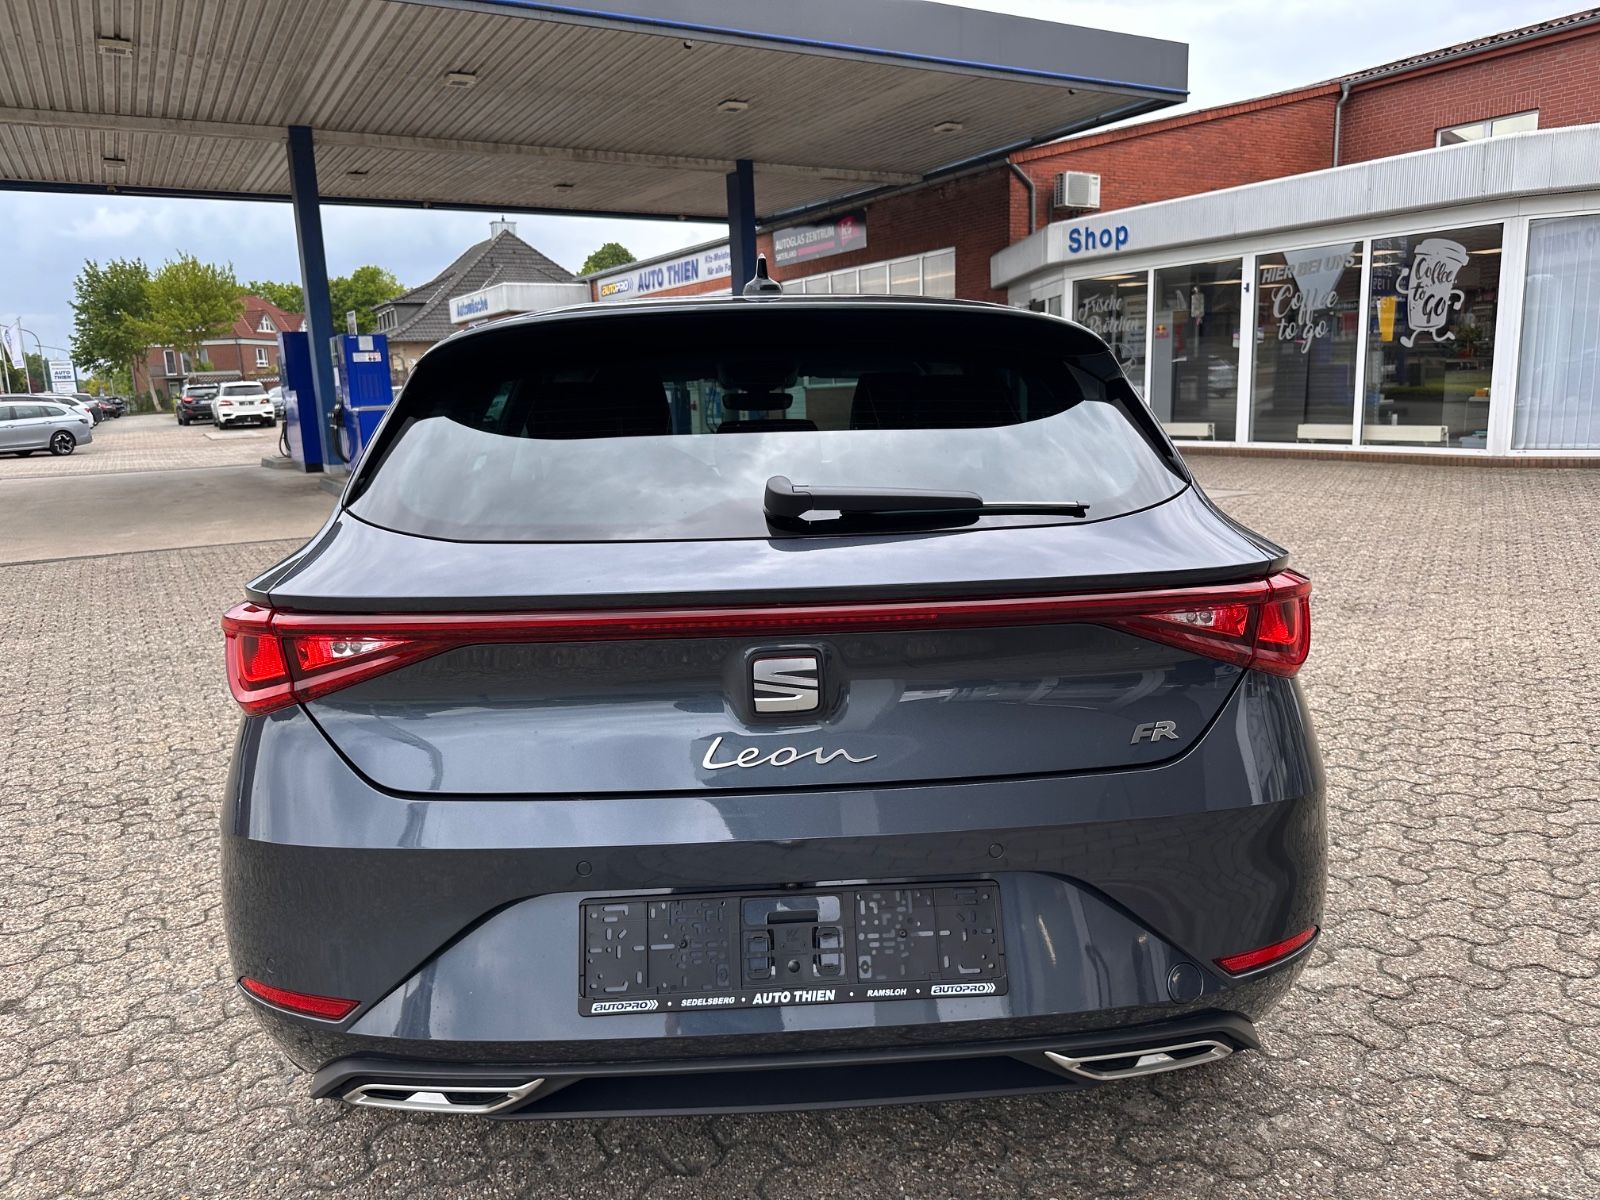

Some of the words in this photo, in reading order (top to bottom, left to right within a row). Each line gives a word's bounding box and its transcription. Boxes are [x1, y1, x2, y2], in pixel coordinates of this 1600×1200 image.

[775, 234, 804, 250] AUTOGLAS
[806, 226, 834, 243] ZENTRUM
[1068, 226, 1128, 253] Shop
[638, 267, 664, 293] AUTO
[667, 259, 699, 286] THIEN
[1262, 265, 1295, 283] HIER
[1296, 259, 1321, 277] BEI
[1323, 253, 1355, 271] UNS
[1415, 257, 1453, 285] Coffee
[1271, 284, 1338, 325] Coffee
[1411, 281, 1426, 301] to
[1078, 293, 1122, 320] Frische
[1276, 318, 1298, 340] to
[1301, 320, 1328, 354] go
[1131, 720, 1179, 744] FR
[702, 736, 878, 770] Leon
[681, 996, 735, 1006] SEDELSBERG
[753, 991, 791, 1004] AUTO
[793, 990, 835, 1003] THIEN
[867, 988, 907, 997] RAMSLOH
